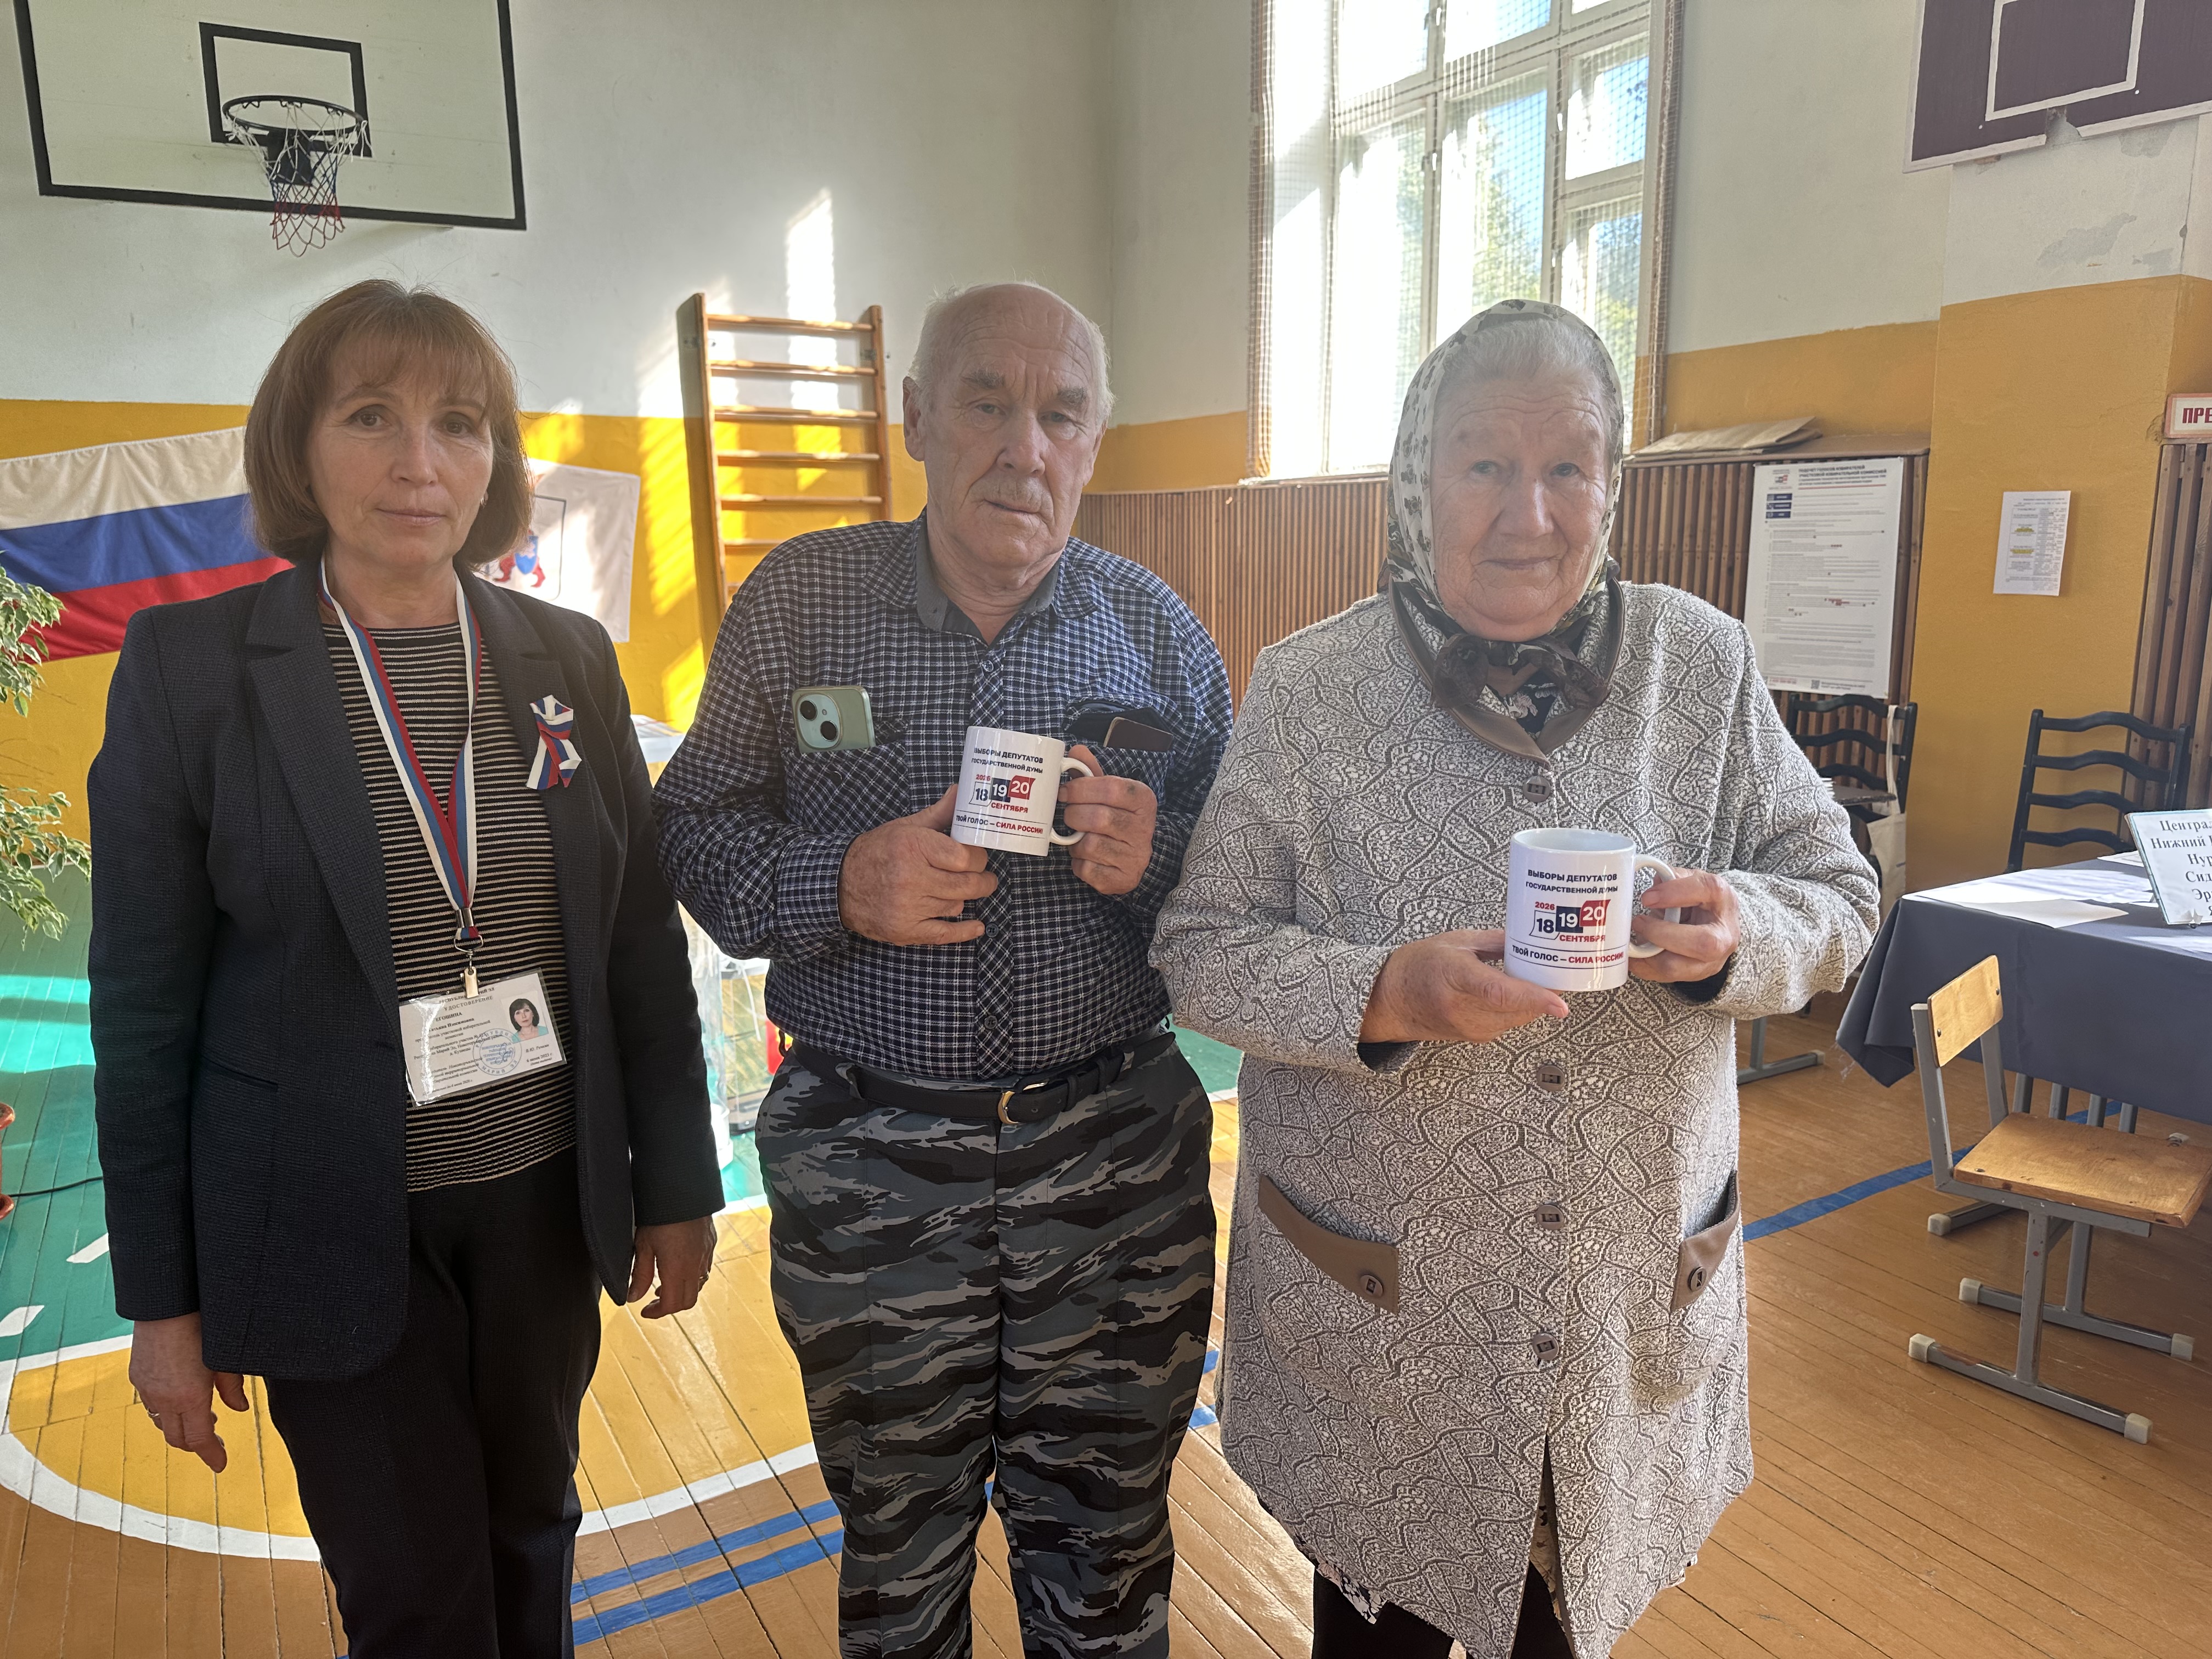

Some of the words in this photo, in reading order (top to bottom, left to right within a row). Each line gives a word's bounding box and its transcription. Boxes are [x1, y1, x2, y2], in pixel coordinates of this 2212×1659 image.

[974, 748, 1001, 757] ВЫБОРЫ
[1002, 752, 1043, 764] ДЕПУТАТОВ
[972, 758, 1025, 770] ГОСУДАРСТВЕННОЙ
[975, 788, 988, 801] 18
[992, 783, 1007, 797] 19
[1011, 780, 1029, 794] 20
[991, 802, 1029, 813] СЕНТЯБРЯ
[967, 817, 989, 826] ГОЛОС
[996, 822, 1015, 830] СИЛА
[2151, 836, 2206, 849] Нижний
[1528, 869, 1565, 881] ВЫБОРЫ
[1566, 873, 1617, 882] ДЕПУТАТОВ
[1526, 882, 1597, 894] ГОСУДАРСТВЕННОЙ
[2191, 888, 2212, 902] Эр
[1535, 901, 1555, 910] 2026
[1537, 918, 1554, 933] 18
[1559, 913, 1578, 928] 19
[1583, 906, 1605, 921] 20
[1512, 945, 1528, 956] ТВОЙ
[1530, 951, 1559, 962] ГОЛОС
[444, 996, 493, 1011] УДОСТОВЕРЕНИЕ
